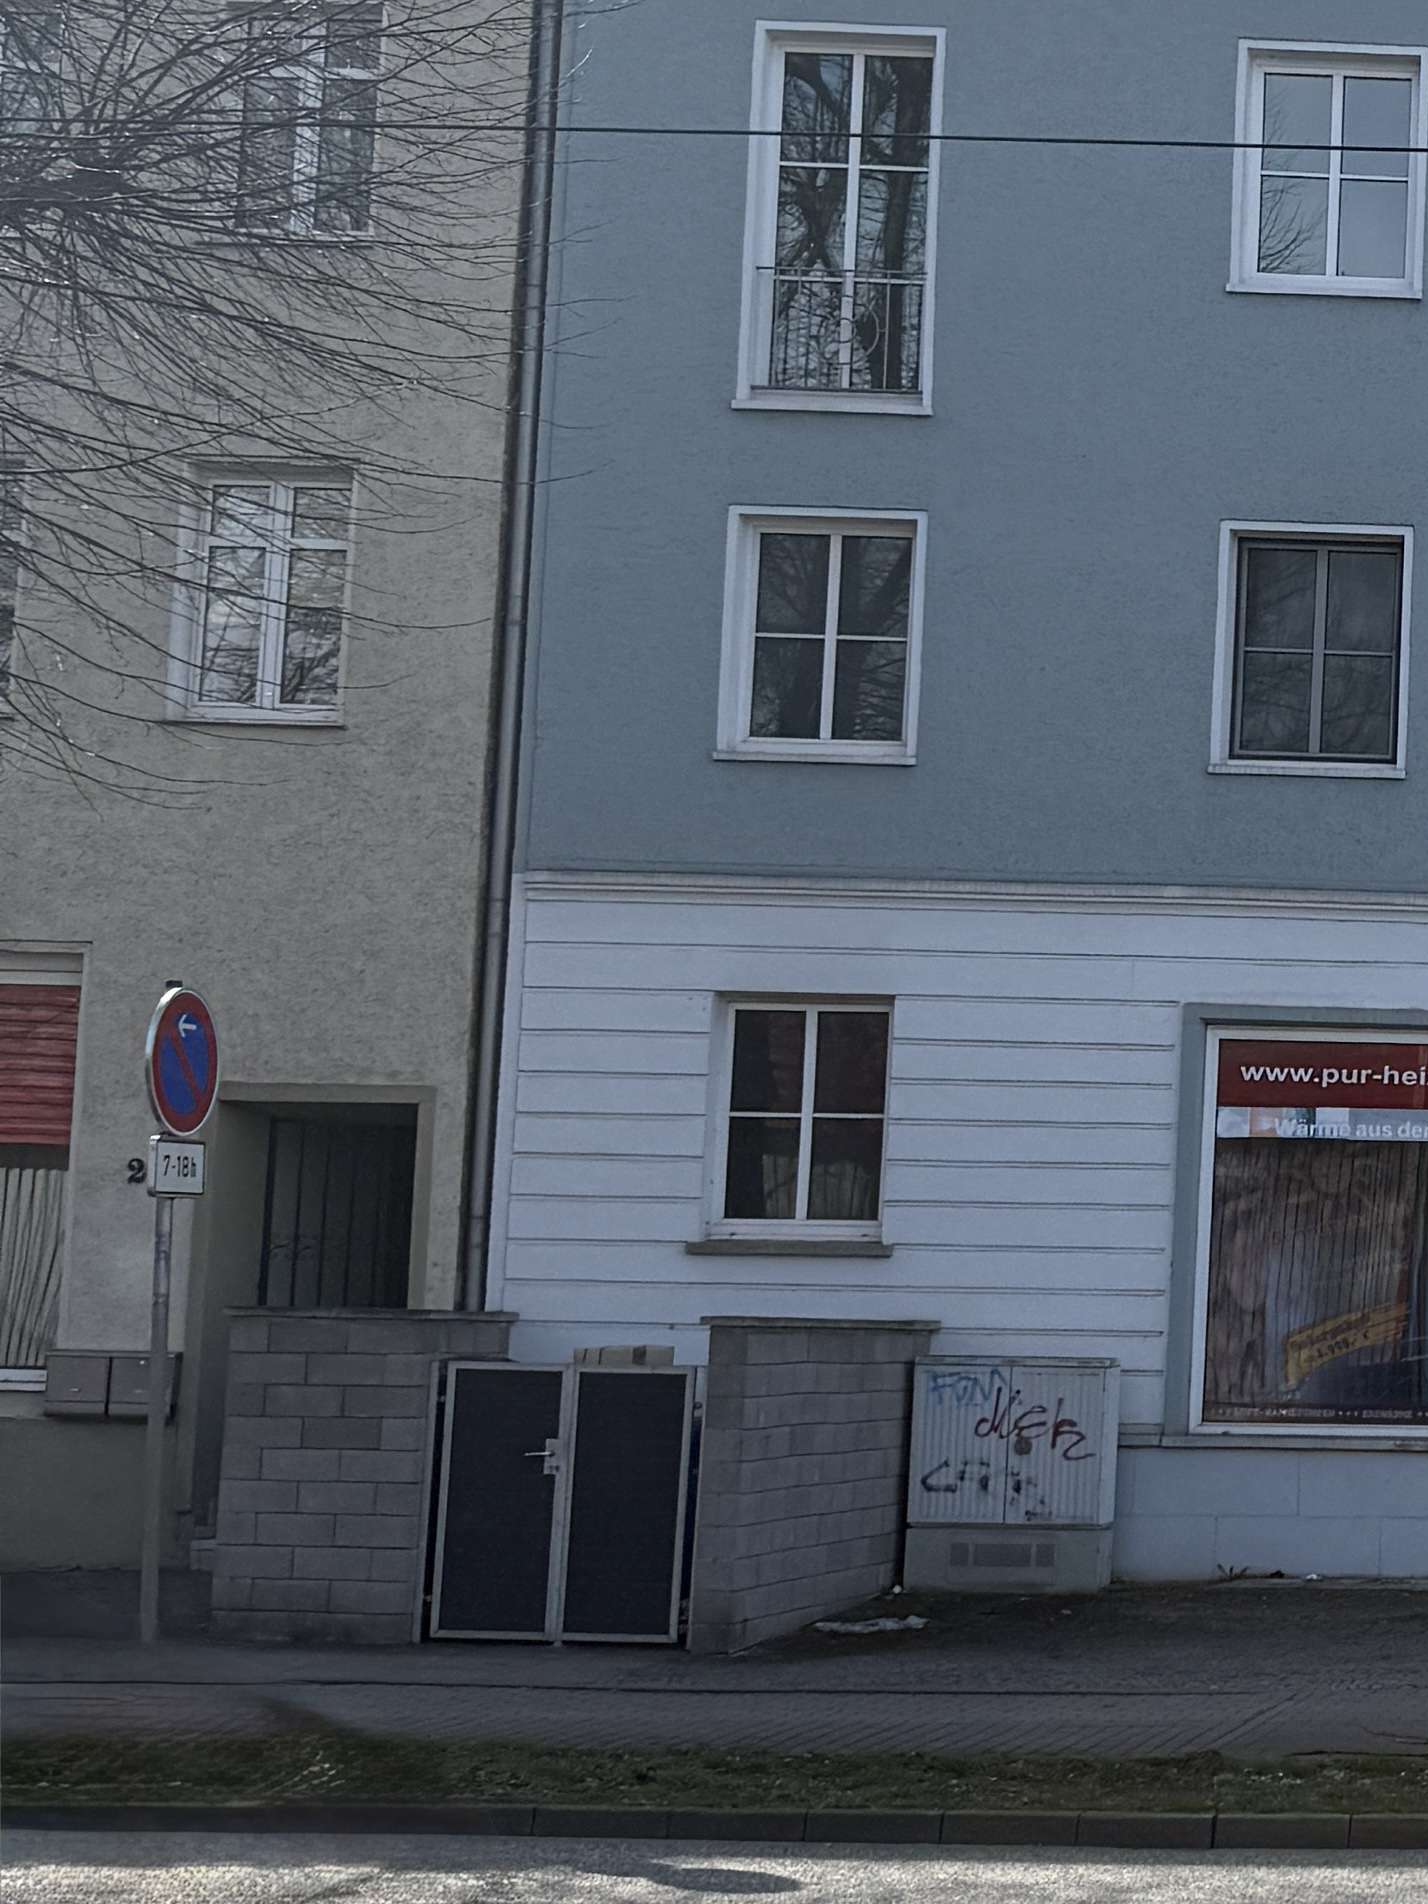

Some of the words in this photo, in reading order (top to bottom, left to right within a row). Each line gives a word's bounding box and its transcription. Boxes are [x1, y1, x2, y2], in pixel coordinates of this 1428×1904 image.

[1274, 1116, 1350, 1138] Wärme
[1355, 1122, 1393, 1138] aus
[127, 1158, 147, 1184] 2
